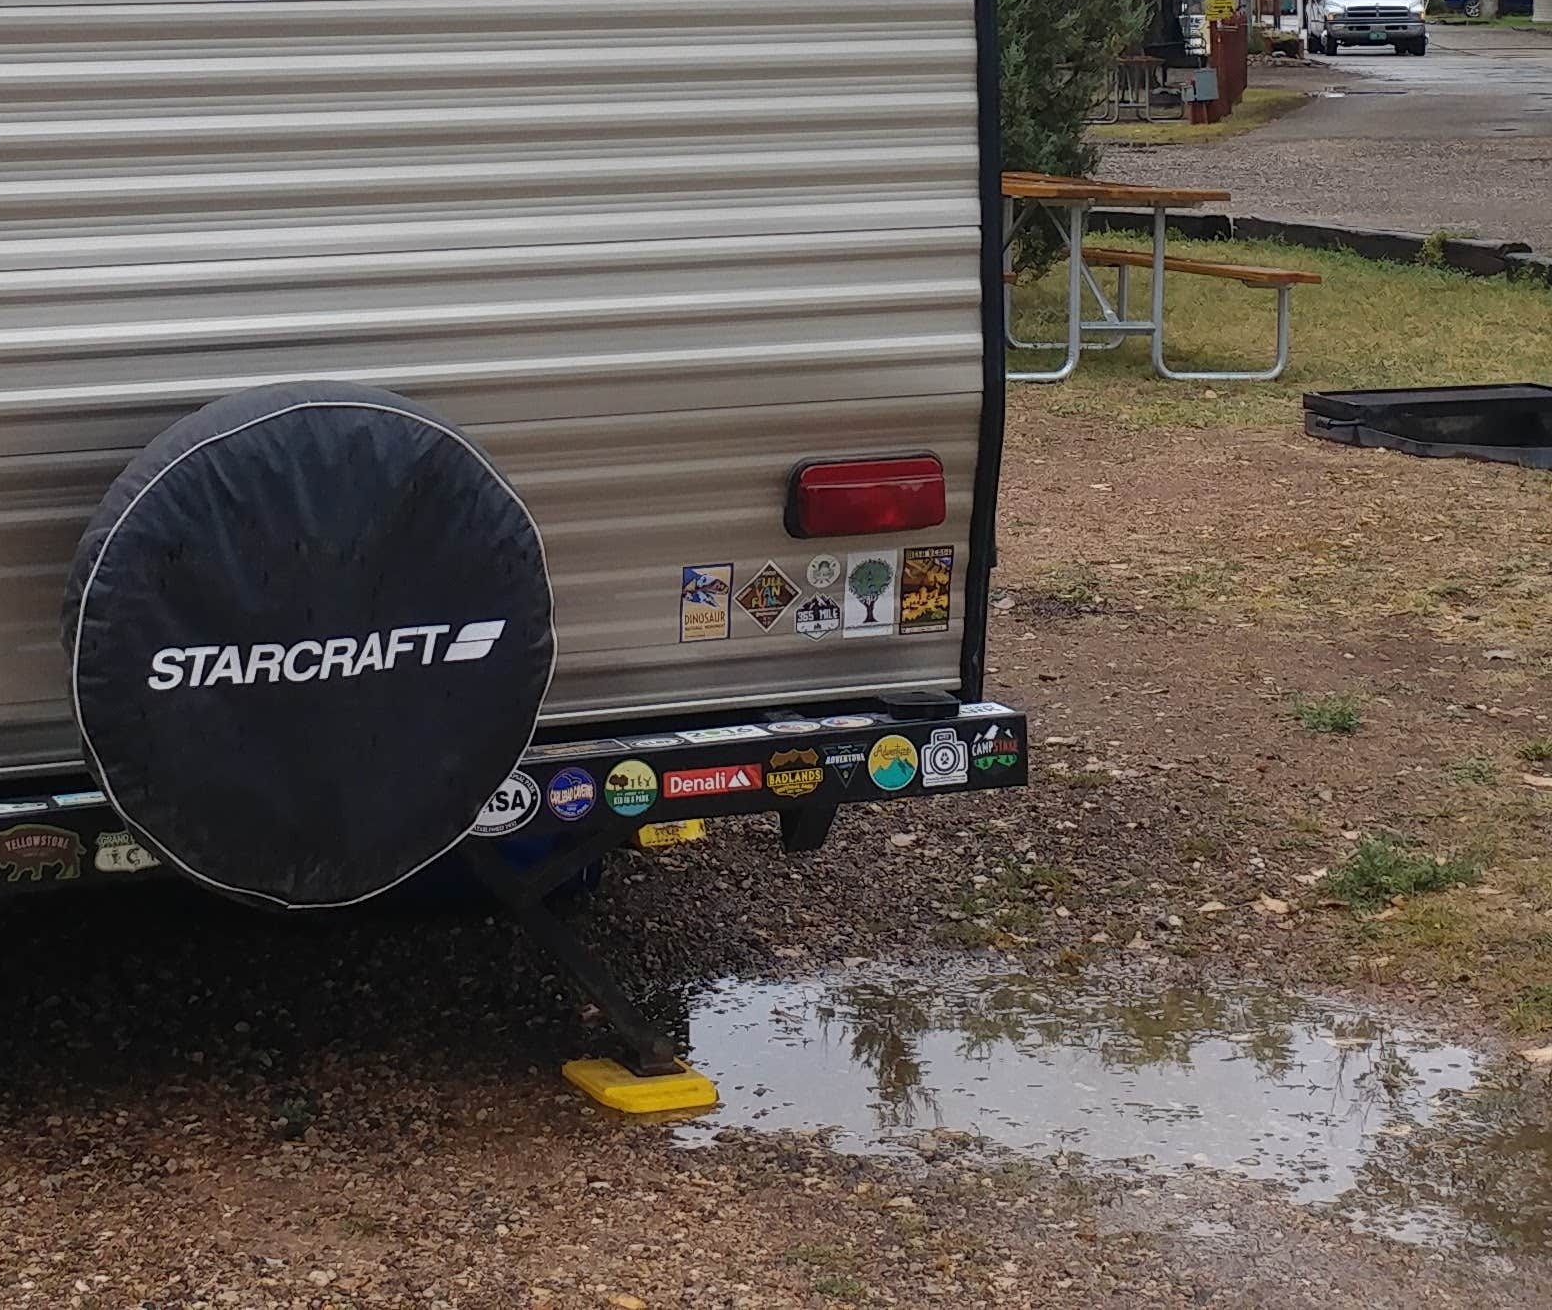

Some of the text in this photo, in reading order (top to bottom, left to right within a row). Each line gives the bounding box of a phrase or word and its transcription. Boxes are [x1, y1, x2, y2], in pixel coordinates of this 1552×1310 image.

[684, 610, 726, 626] DINOSAUR
[148, 622, 451, 691] STARCRAFT
[670, 771, 726, 794] Denali
[768, 769, 821, 785] BADLANDS
[4, 834, 70, 852] YELLOWSTONE
